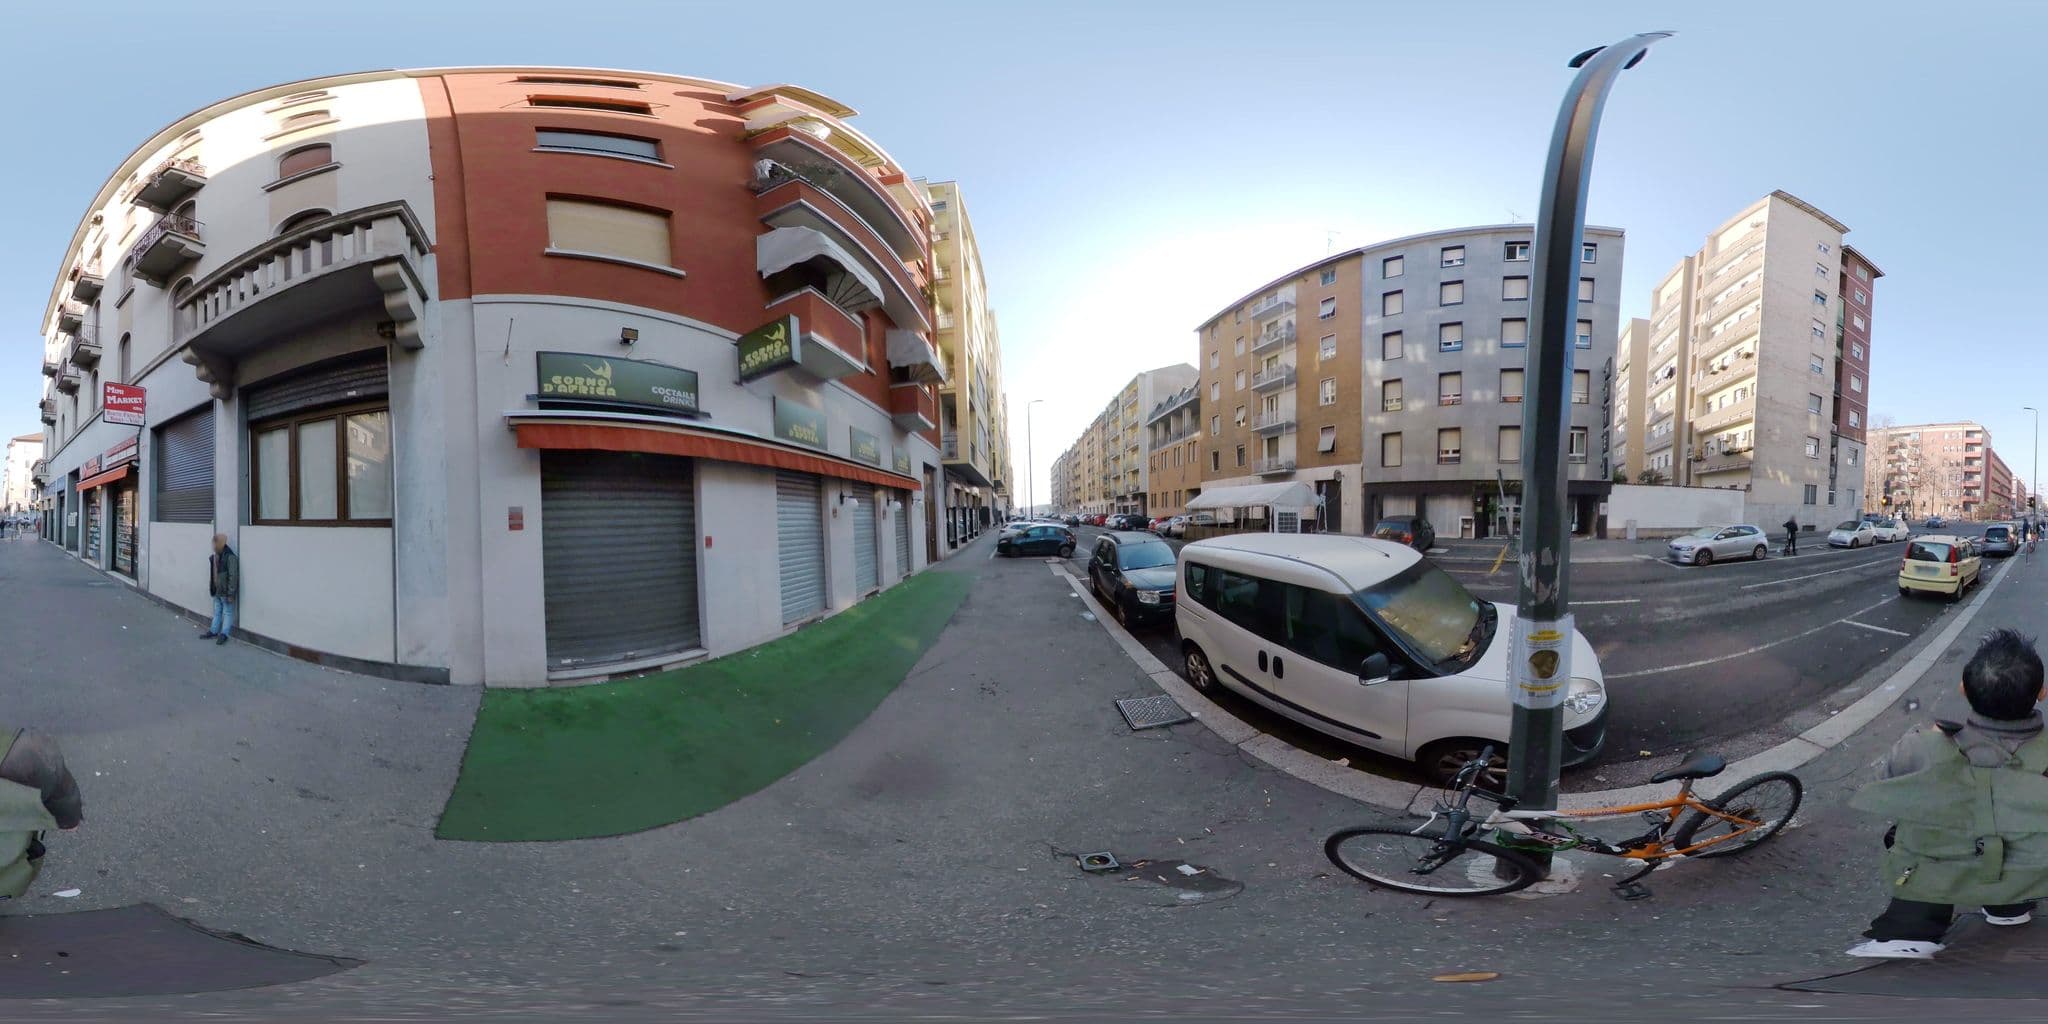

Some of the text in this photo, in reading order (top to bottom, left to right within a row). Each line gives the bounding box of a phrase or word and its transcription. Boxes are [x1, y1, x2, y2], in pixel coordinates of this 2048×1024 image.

[745, 340, 782, 361] CORNO
[551, 375, 608, 387] CORNO
[543, 383, 616, 397] D'AFRICA
[106, 395, 143, 404] MARKET
